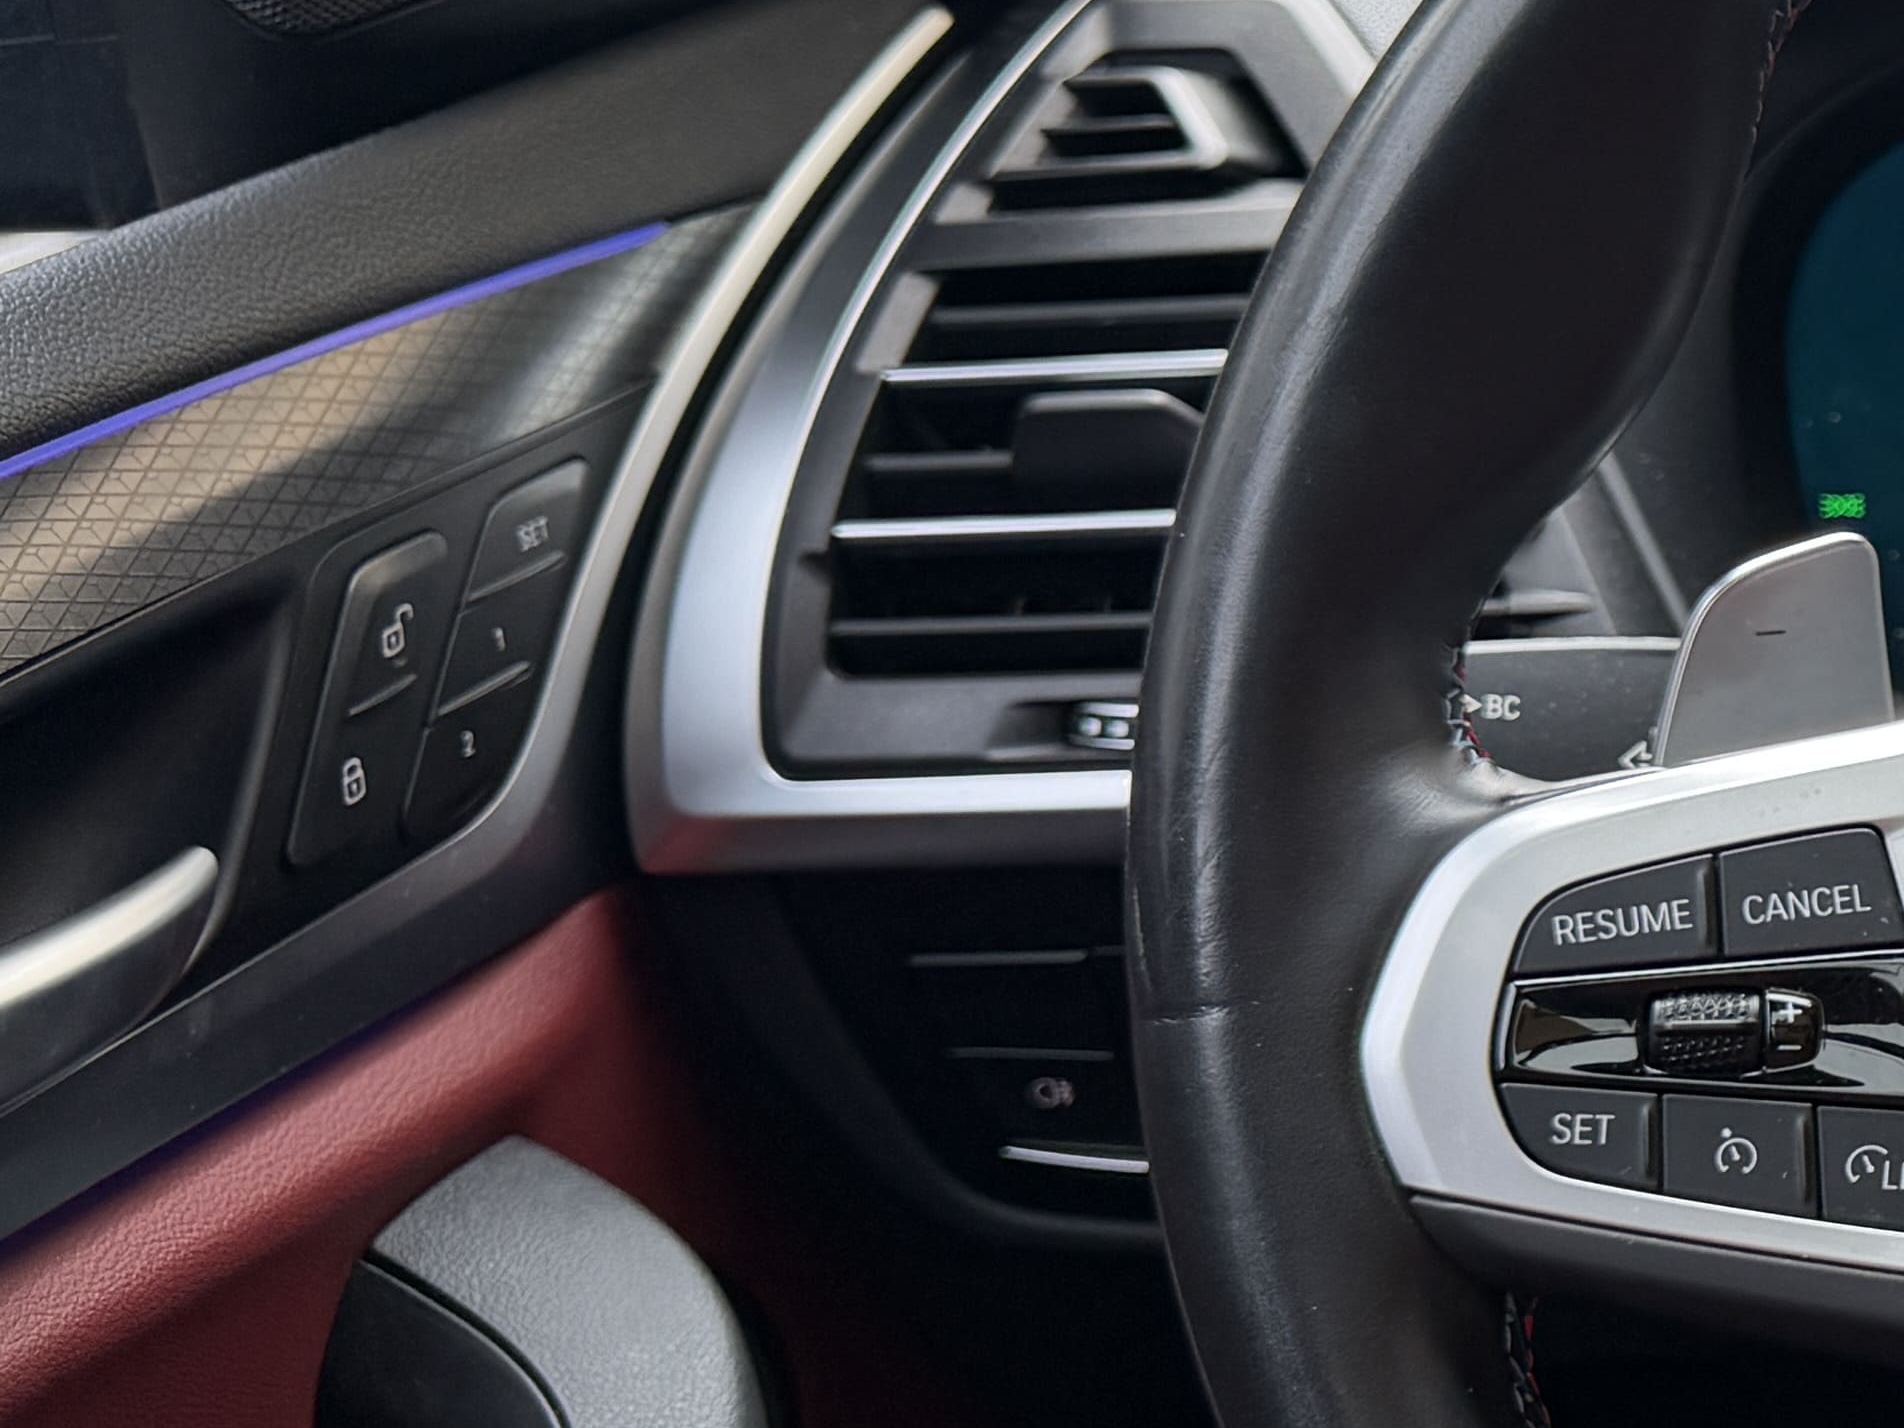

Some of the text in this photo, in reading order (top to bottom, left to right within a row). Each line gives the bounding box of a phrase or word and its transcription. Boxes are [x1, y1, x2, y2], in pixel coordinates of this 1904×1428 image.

[1480, 693, 1521, 721] BC
[460, 730, 477, 758] 2
[1742, 882, 1873, 926] CANCEL
[1551, 898, 1694, 946] RESUME
[1549, 1112, 1616, 1147] SET
